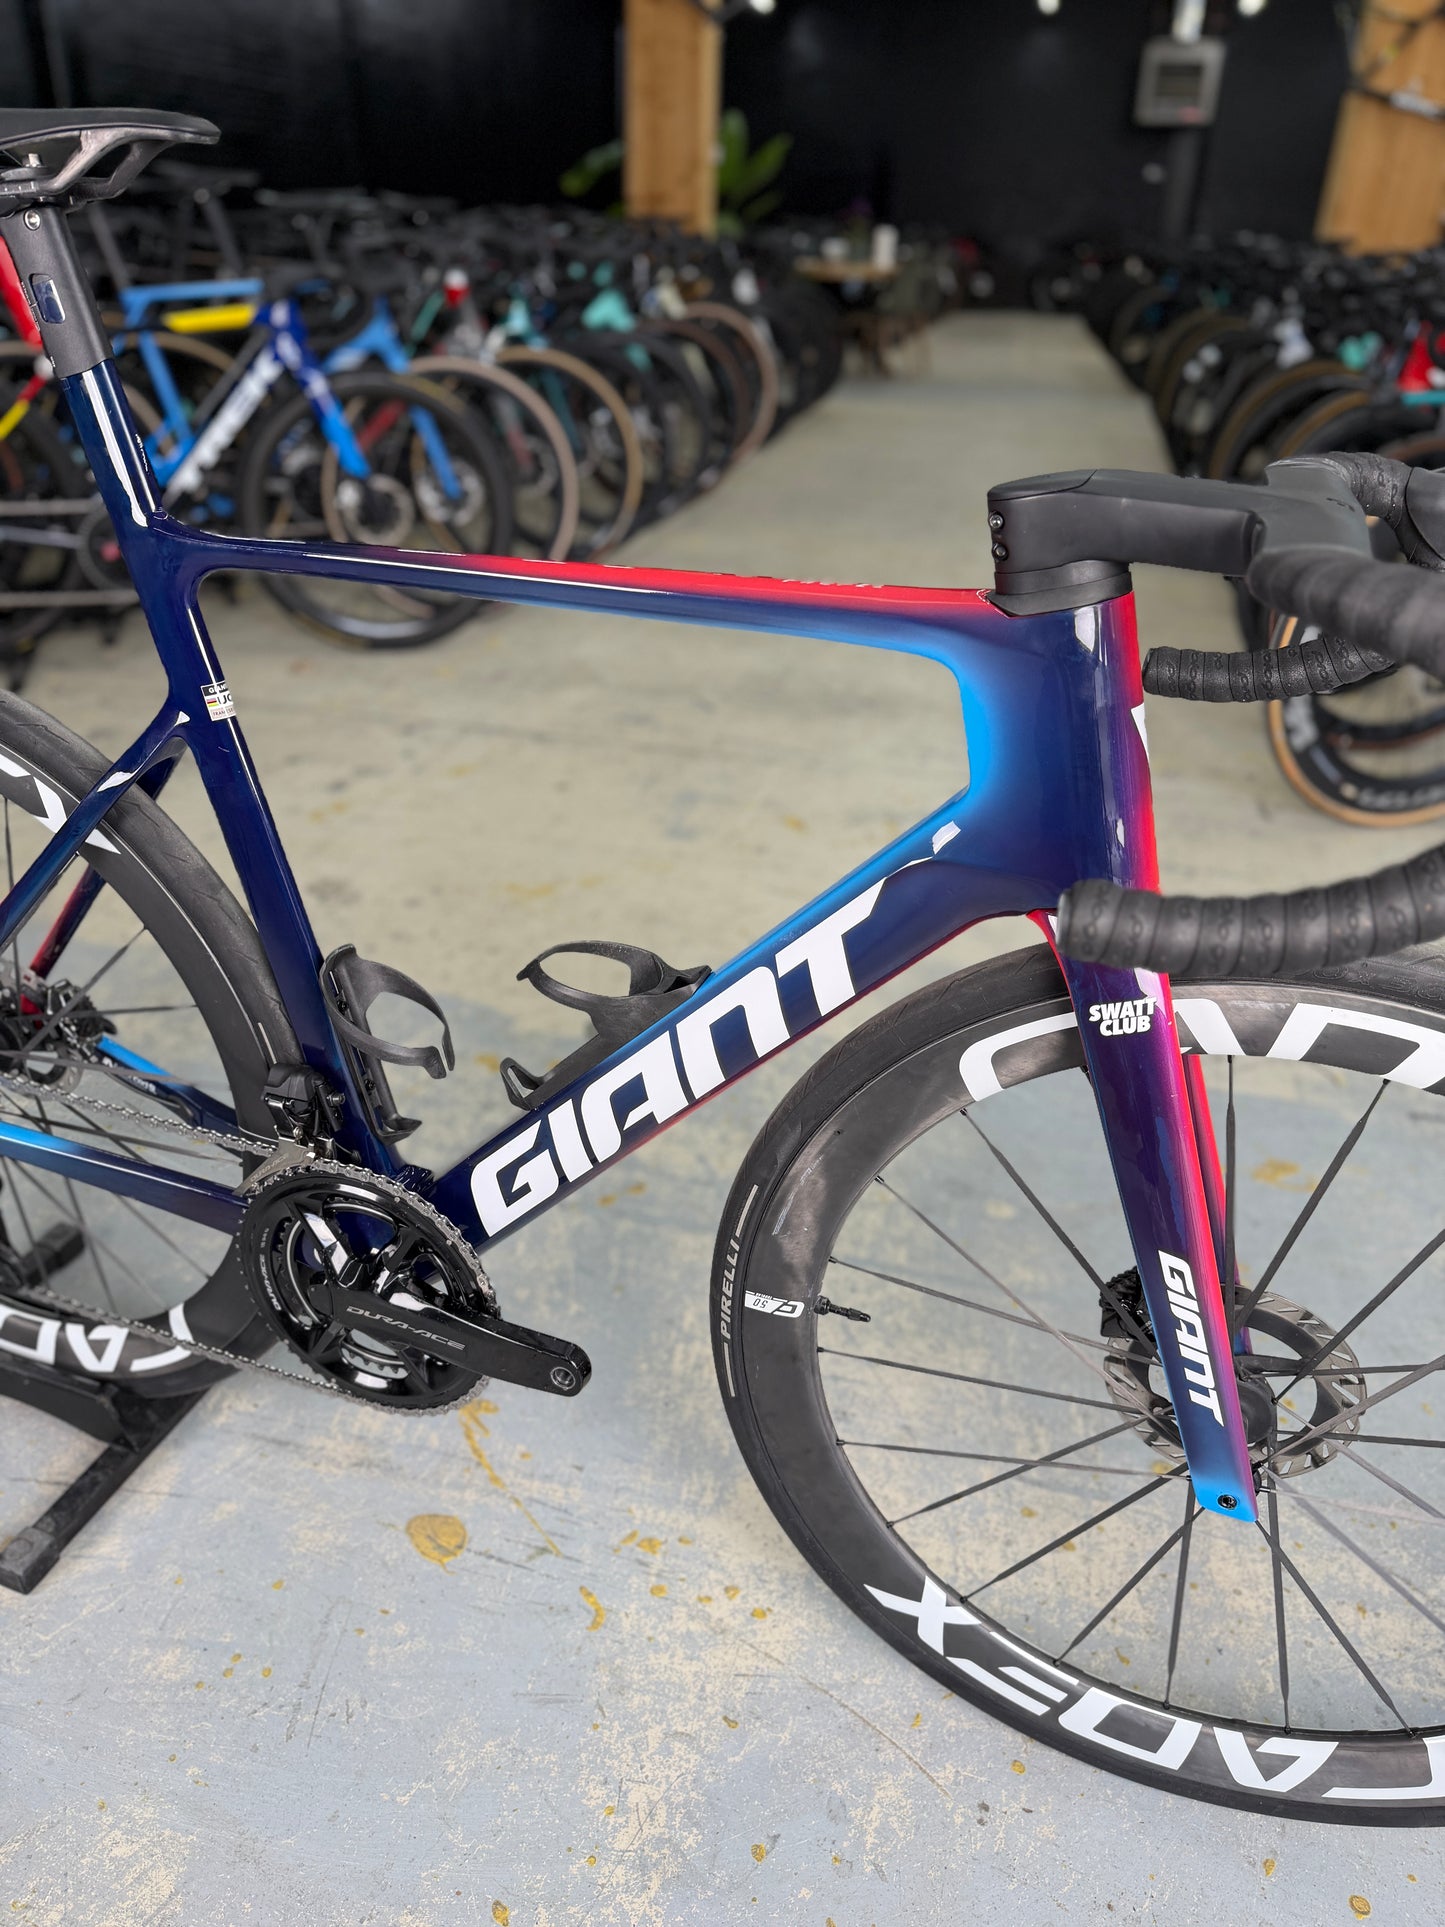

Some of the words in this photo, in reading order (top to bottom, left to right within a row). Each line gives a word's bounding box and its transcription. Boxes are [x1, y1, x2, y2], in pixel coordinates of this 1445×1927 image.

[1088, 997, 1157, 1022] SWATT
[1099, 1015, 1151, 1037] CLUB
[471, 877, 887, 1238] GIANT
[720, 1238, 740, 1340] PIRELLI
[346, 1305, 467, 1351] DURA-ACE
[1158, 1250, 1225, 1427] GIANT
